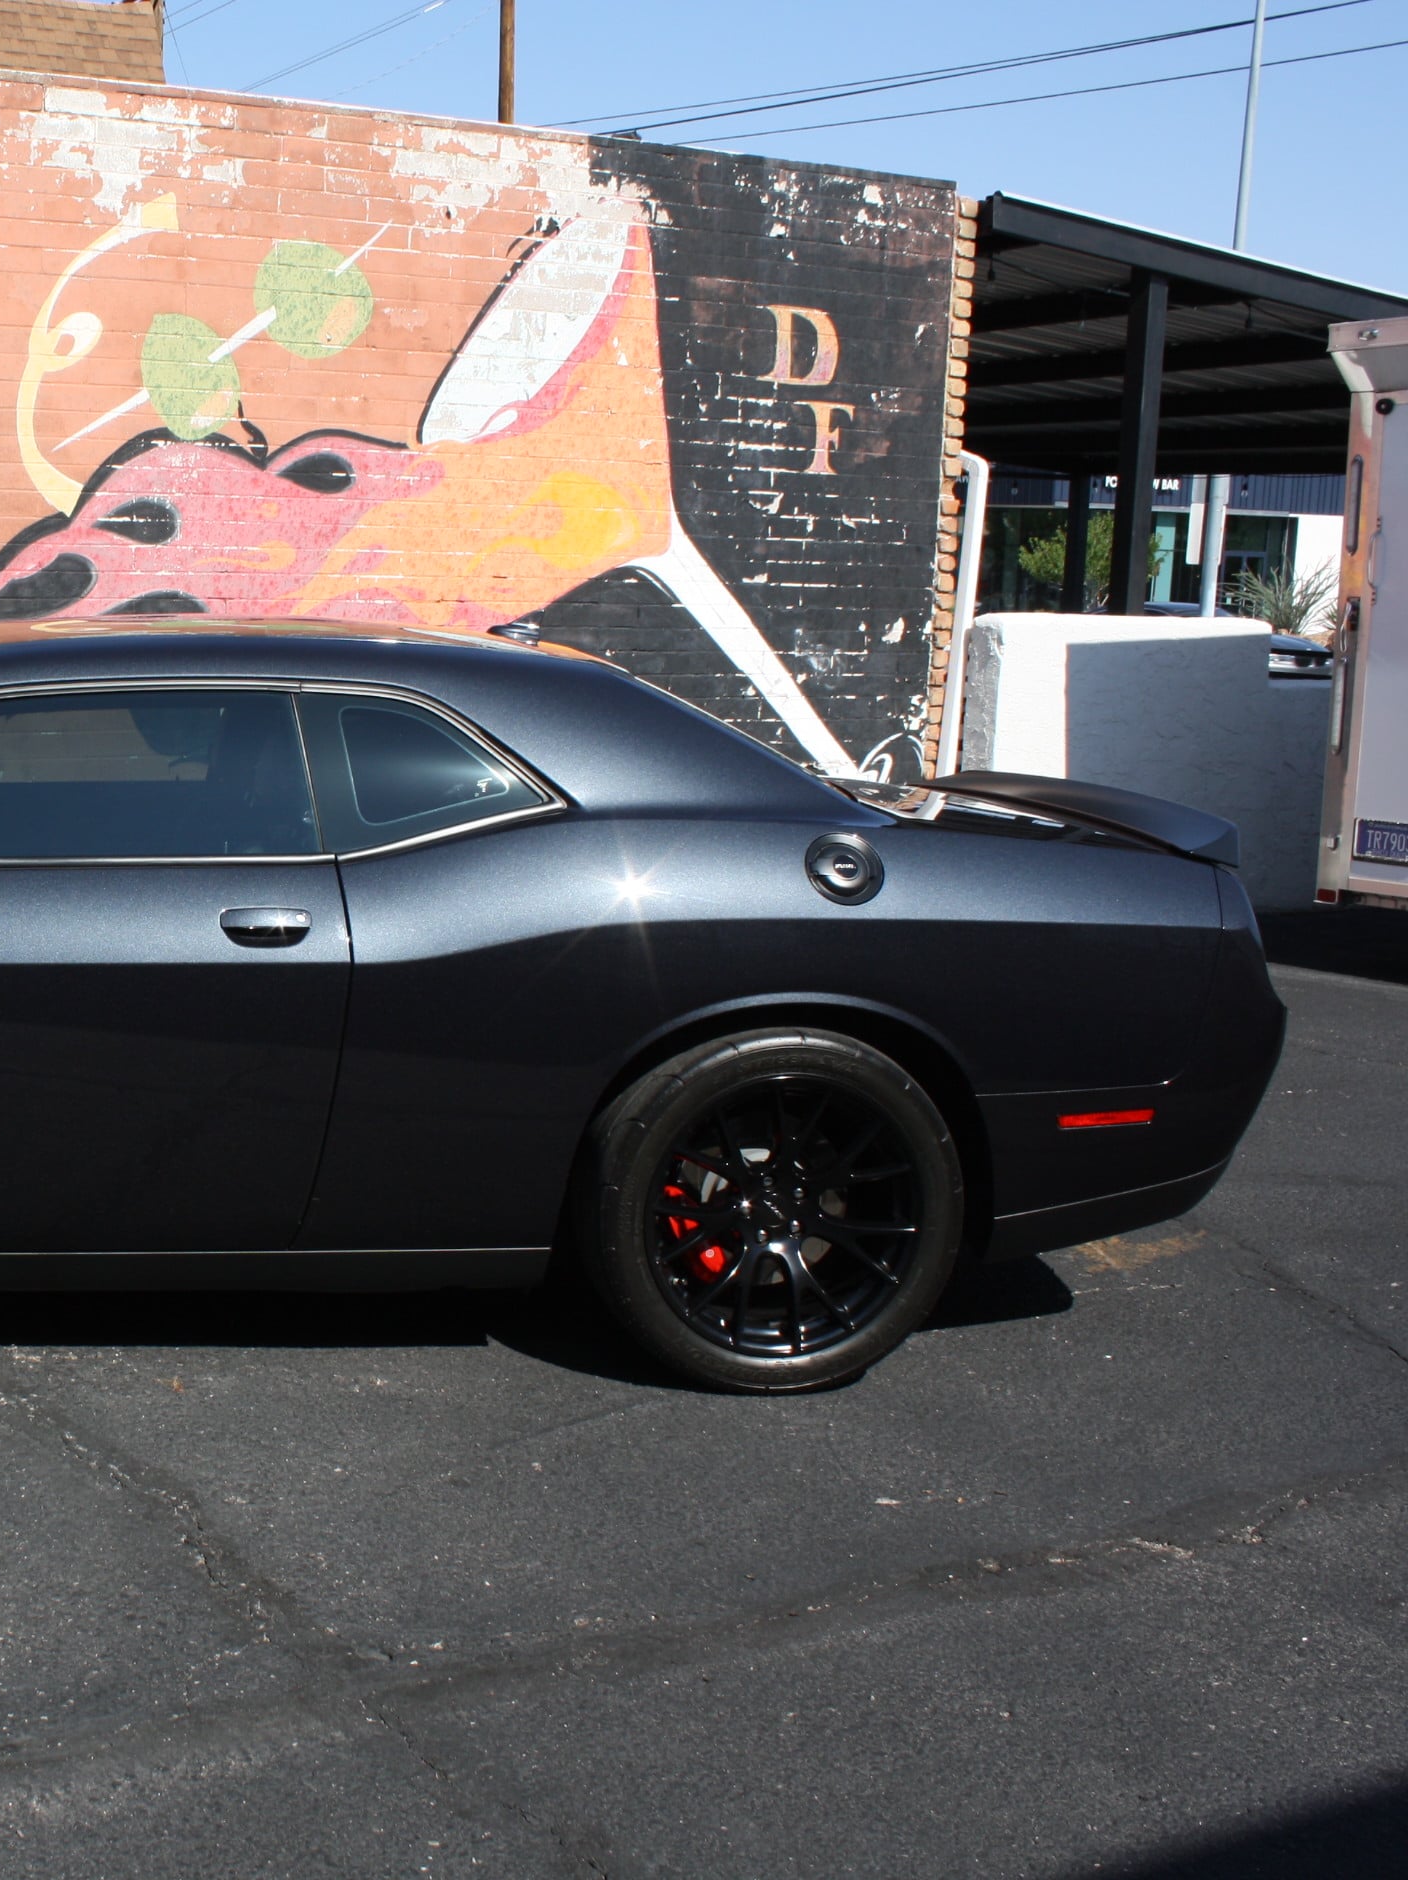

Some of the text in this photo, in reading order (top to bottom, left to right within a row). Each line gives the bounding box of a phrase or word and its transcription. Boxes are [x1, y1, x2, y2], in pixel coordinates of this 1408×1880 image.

[756, 304, 839, 386] D
[793, 400, 856, 476] F
[1161, 478, 1180, 491] BAR
[1366, 829, 1408, 853] TR790
